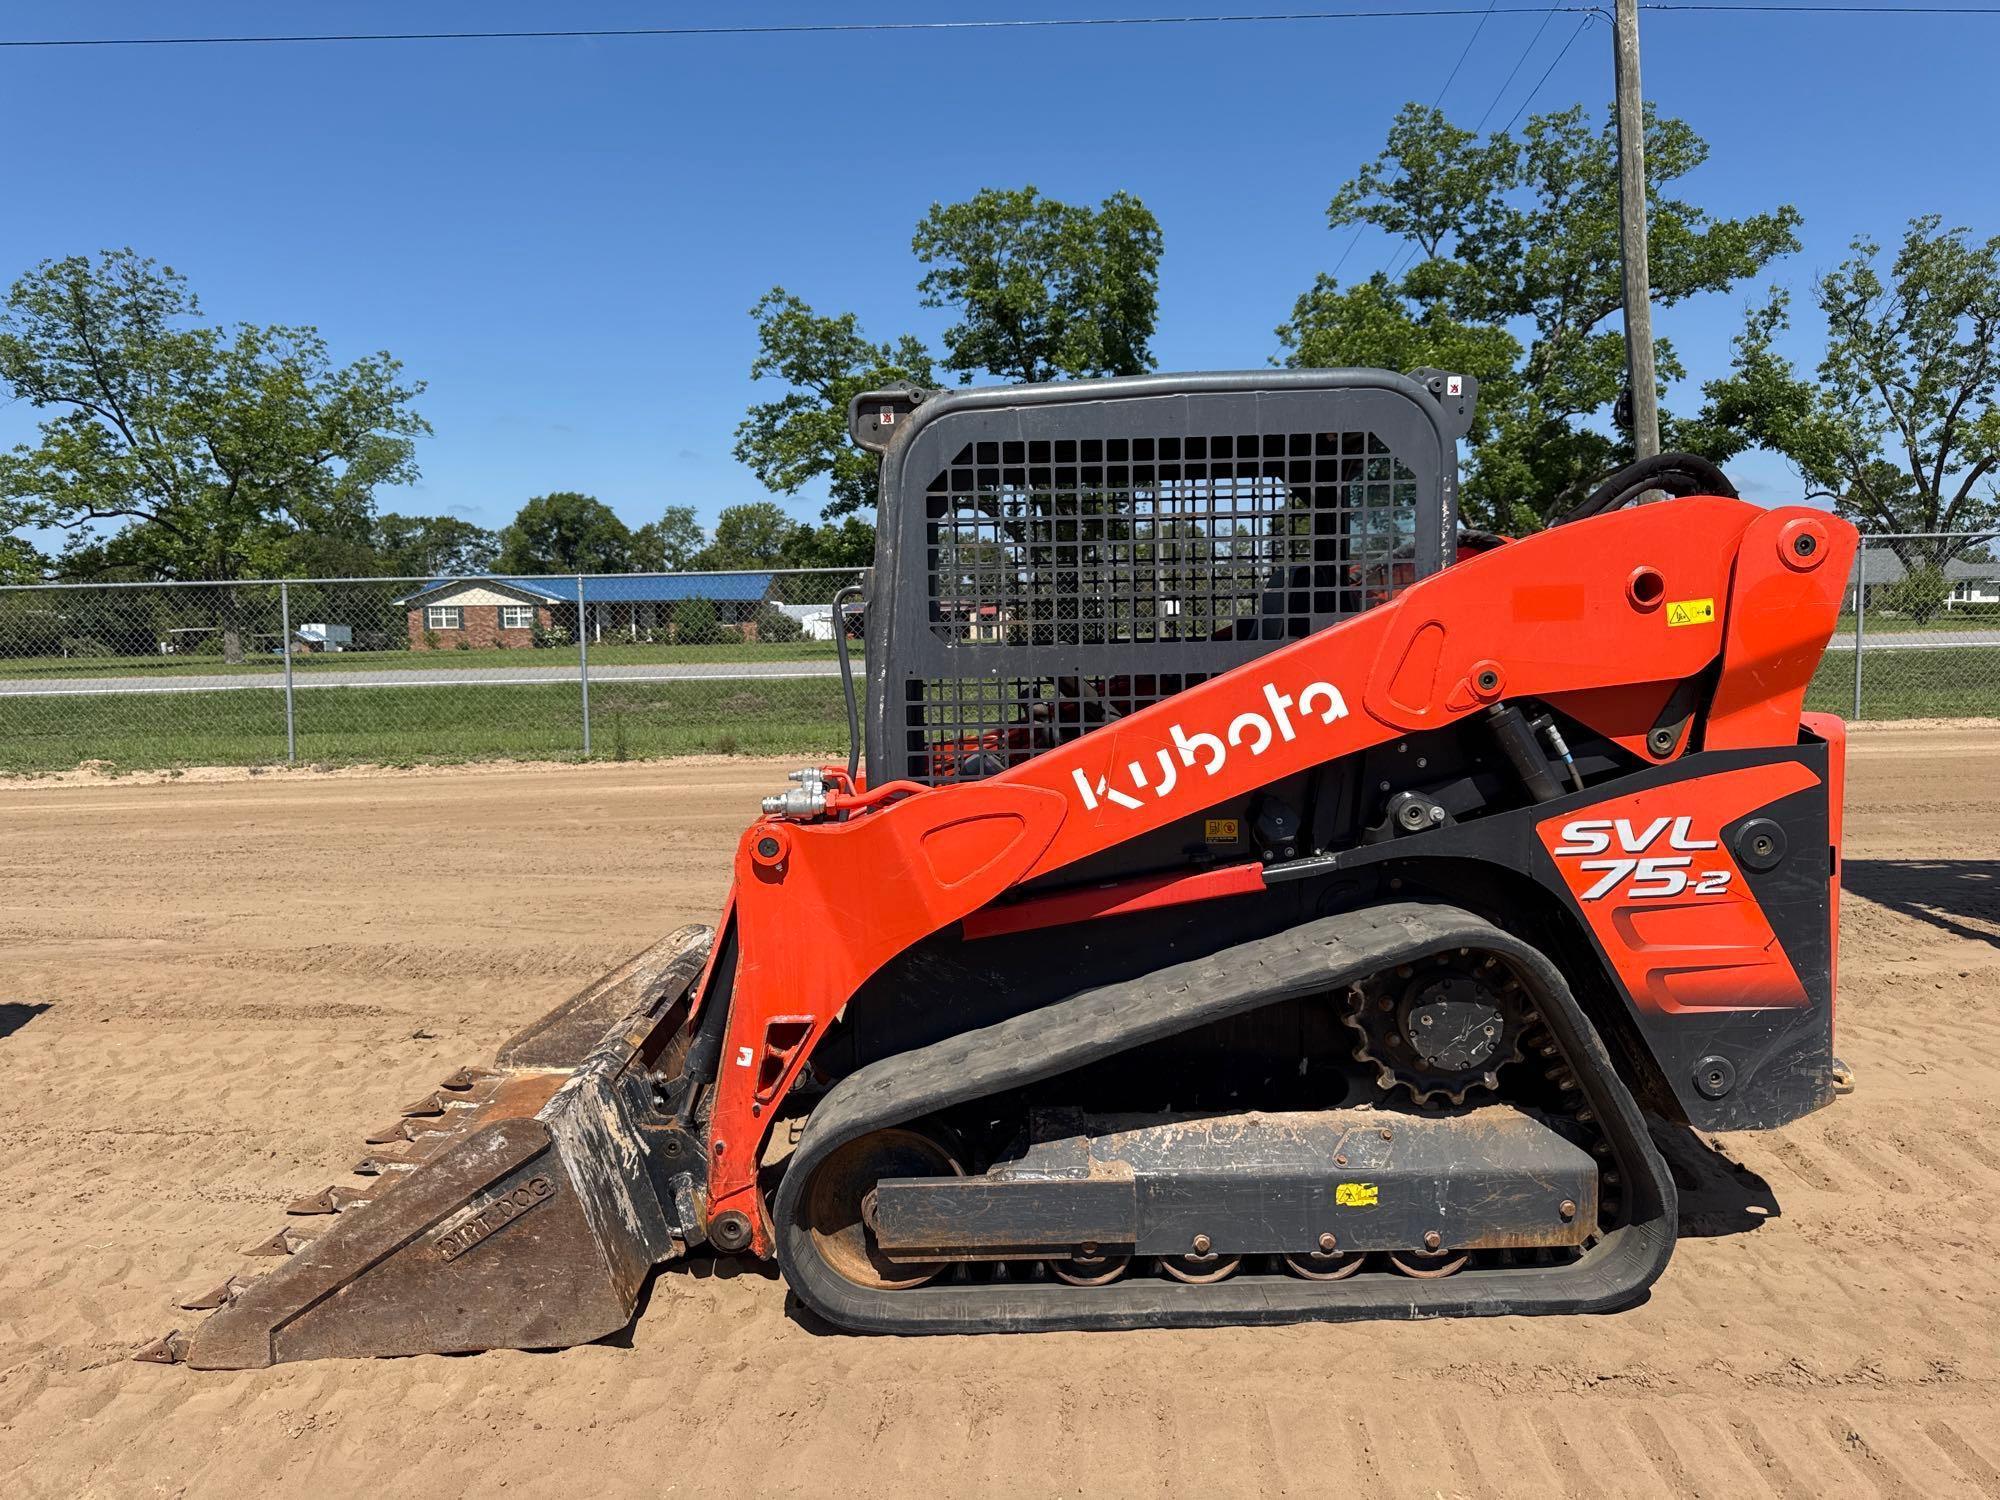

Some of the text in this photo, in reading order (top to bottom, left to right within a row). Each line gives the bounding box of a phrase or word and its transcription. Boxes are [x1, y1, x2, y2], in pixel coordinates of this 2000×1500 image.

[1554, 816, 1718, 856] SVL
[1579, 856, 1732, 901] 75-2
[437, 1178, 554, 1258] DIRT DOG
